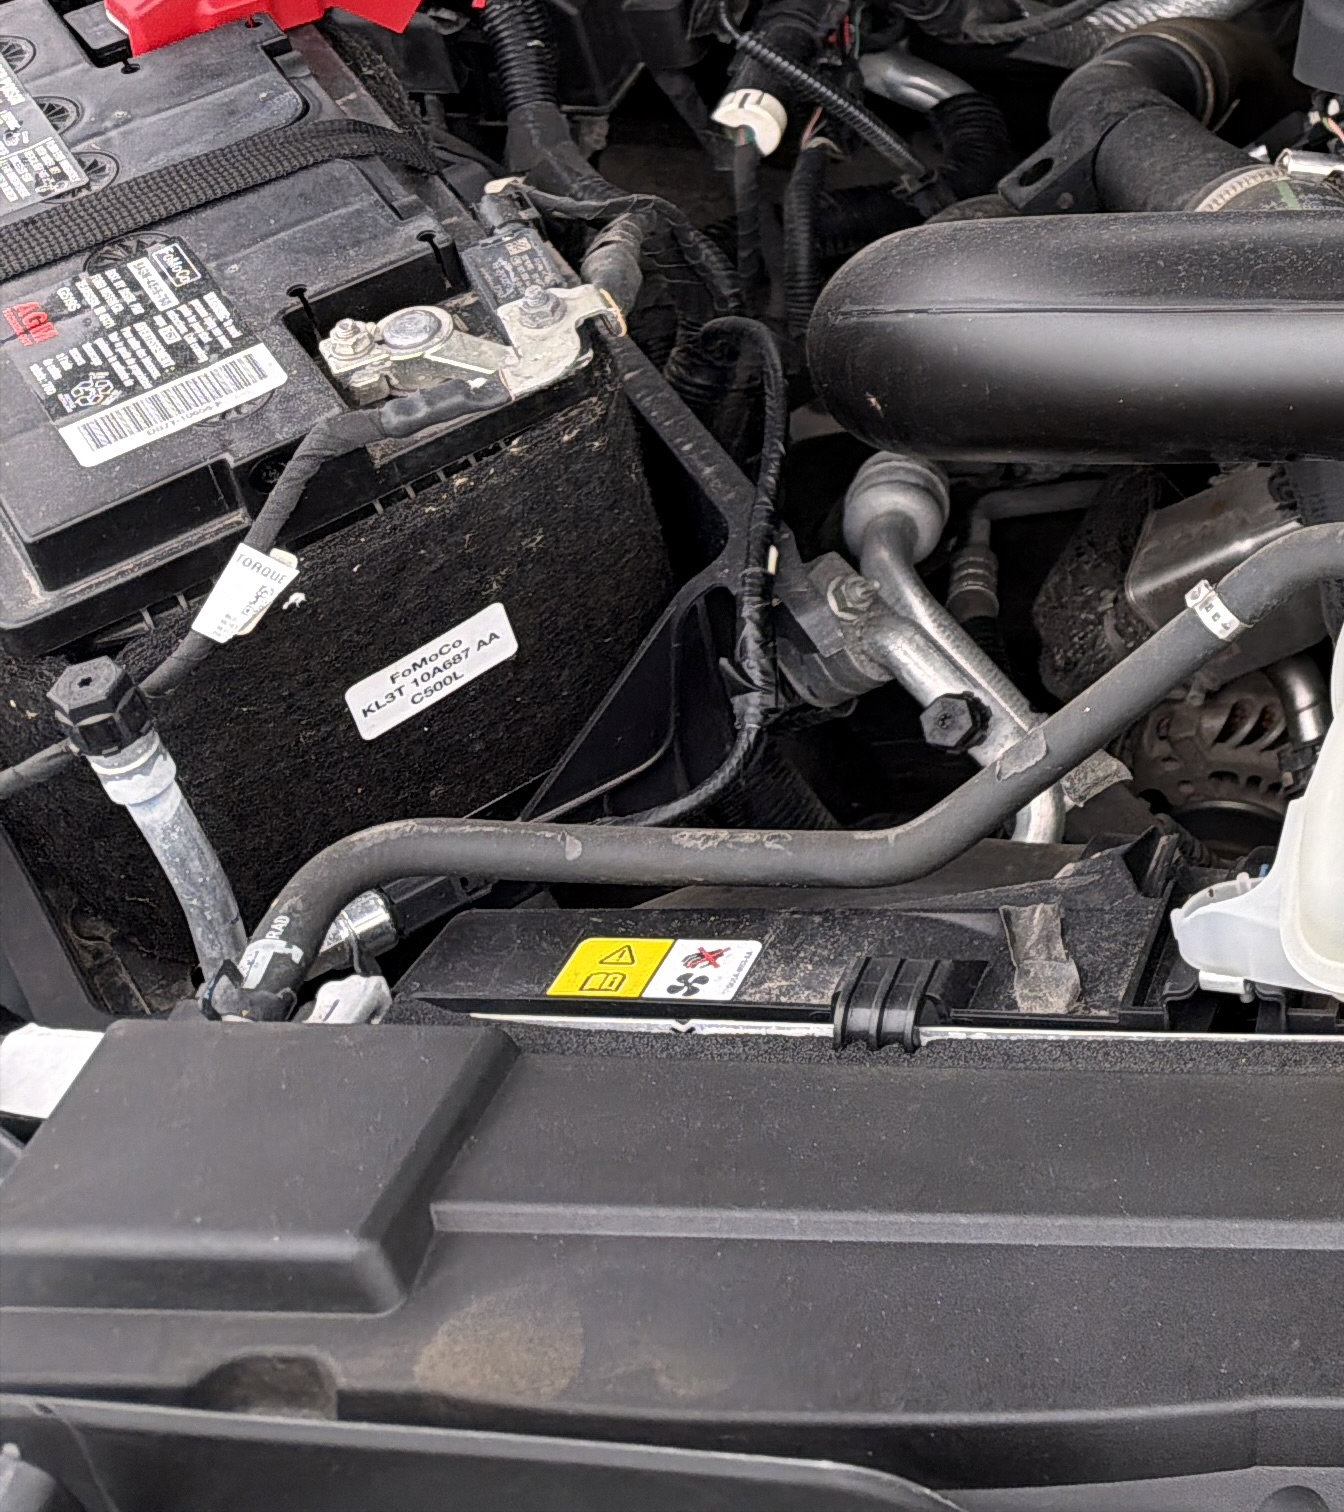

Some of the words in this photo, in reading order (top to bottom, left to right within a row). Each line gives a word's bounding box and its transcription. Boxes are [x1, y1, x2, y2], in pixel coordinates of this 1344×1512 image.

[160, 246, 196, 285] FoMoCo
[14, 301, 59, 343] AGM
[235, 553, 288, 585] TORQUE
[361, 685, 406, 718] KL3T
[411, 648, 471, 688] 10A687
[476, 631, 501, 652] AA
[389, 638, 464, 685] FoMoCo
[410, 671, 465, 706] C500L
[265, 914, 291, 940] RAD
